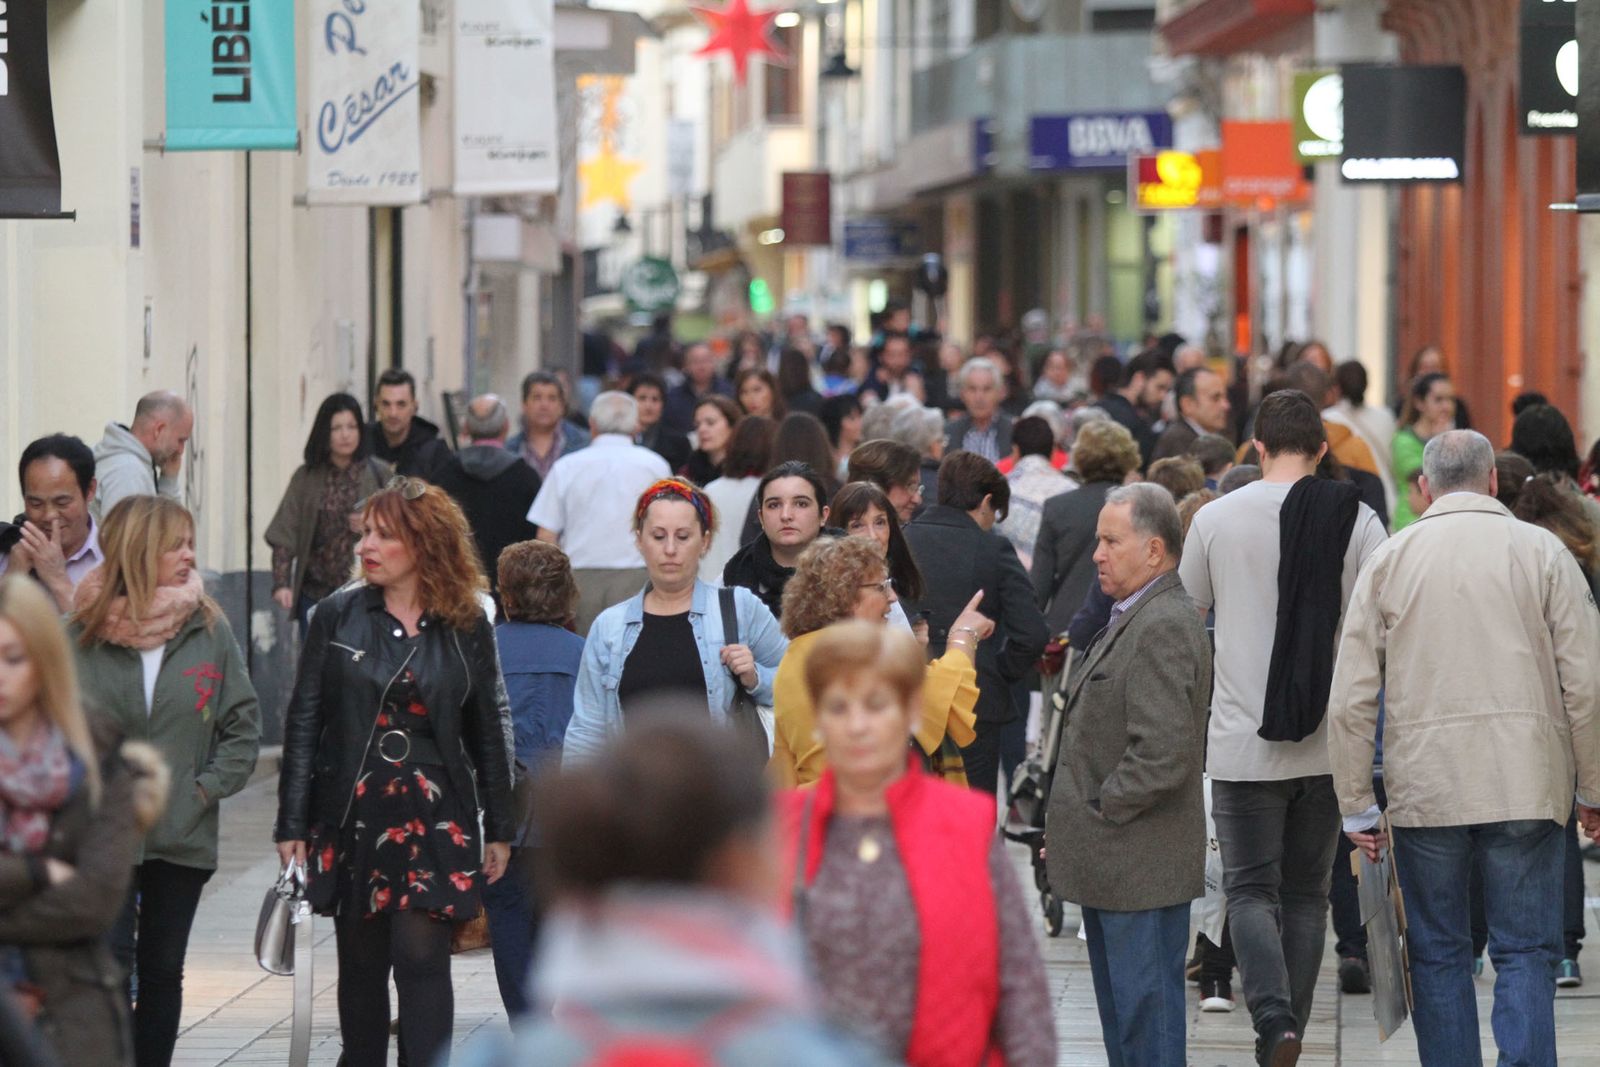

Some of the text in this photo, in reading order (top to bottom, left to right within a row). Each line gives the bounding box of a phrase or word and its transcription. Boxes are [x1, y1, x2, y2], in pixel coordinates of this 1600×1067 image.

[201, 0, 251, 103] LIBÉ
[318, 61, 410, 153] César
[1067, 116, 1153, 157] BBVA
